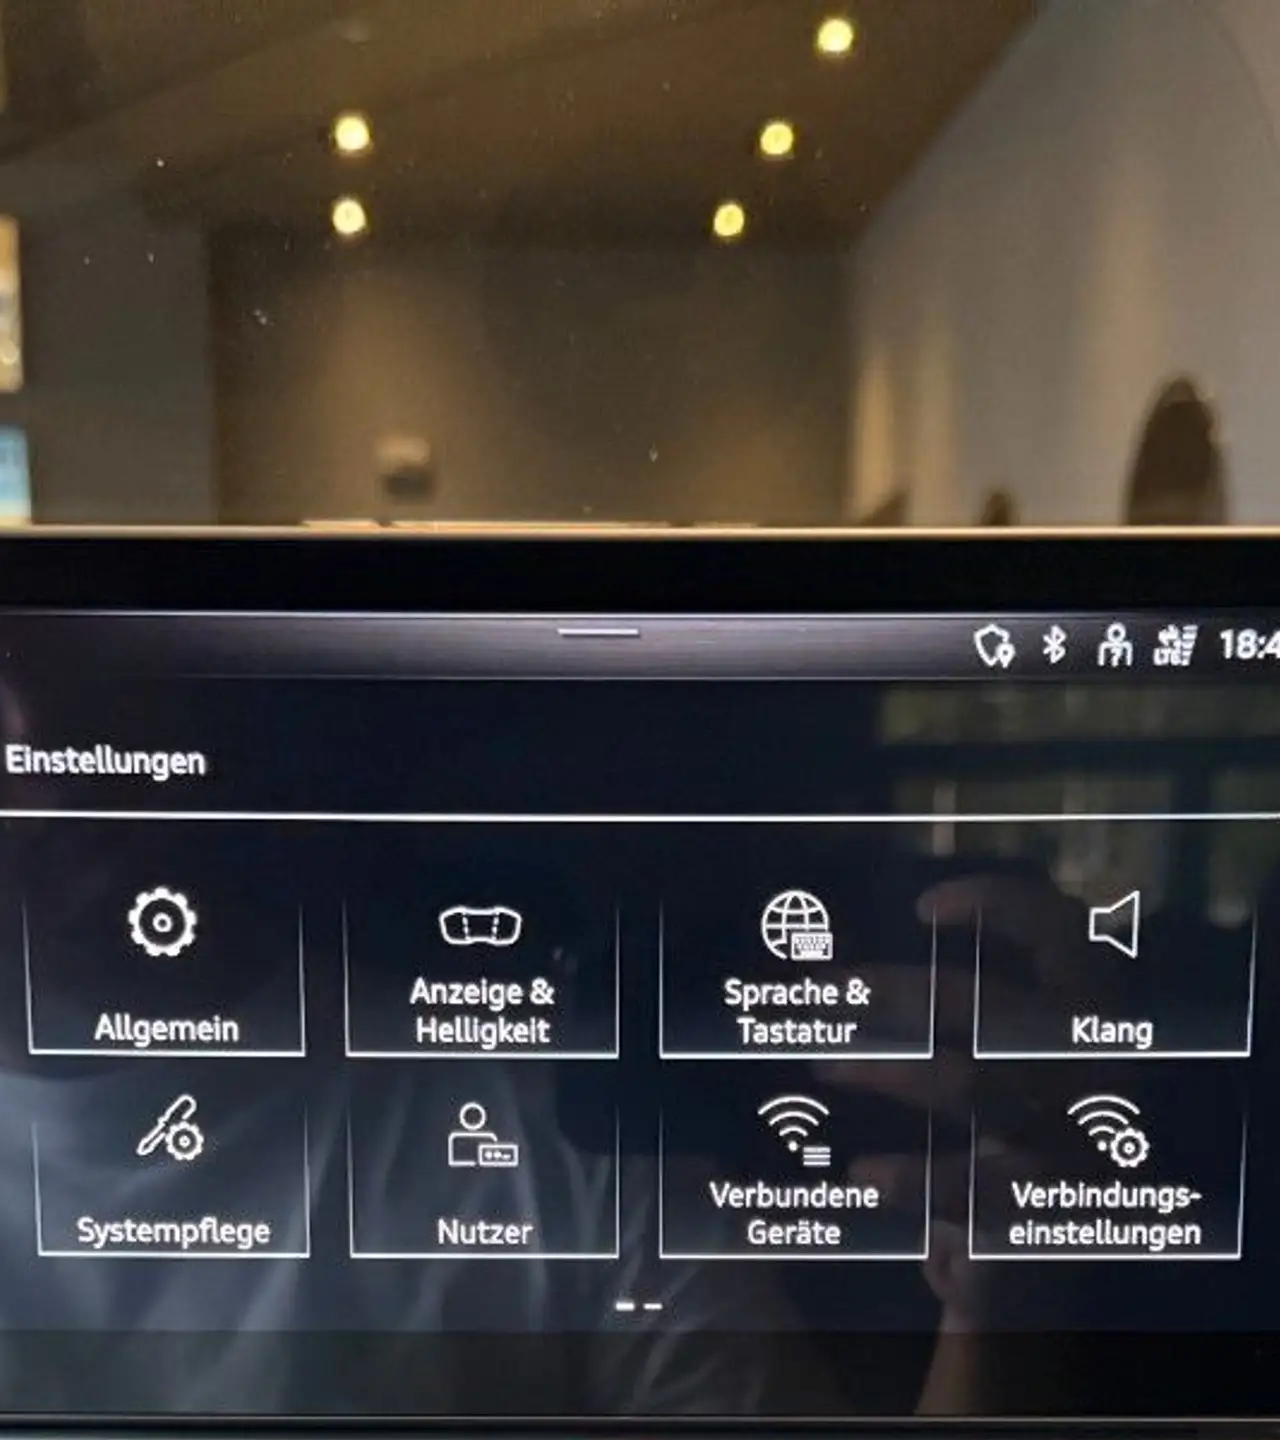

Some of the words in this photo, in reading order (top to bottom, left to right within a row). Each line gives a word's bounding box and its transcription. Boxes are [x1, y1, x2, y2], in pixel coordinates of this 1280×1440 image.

[5, 743, 206, 782] Einstellungen
[409, 976, 524, 1008] Anzeige
[529, 977, 555, 1005] &
[724, 977, 839, 1009] Sprache
[845, 978, 871, 1005] &
[94, 1012, 239, 1045] Allgemein
[416, 1016, 551, 1049] Helligkeit
[736, 1018, 858, 1045] Tastatur
[1072, 1015, 1153, 1050] Klang
[709, 1181, 879, 1208] Verbundene
[1011, 1180, 1202, 1214] Verbindungs-
[77, 1216, 271, 1248] Systempflege
[438, 1218, 534, 1245] Nutzer
[747, 1218, 841, 1245] Geräte
[1009, 1219, 1201, 1252] einstellungen
